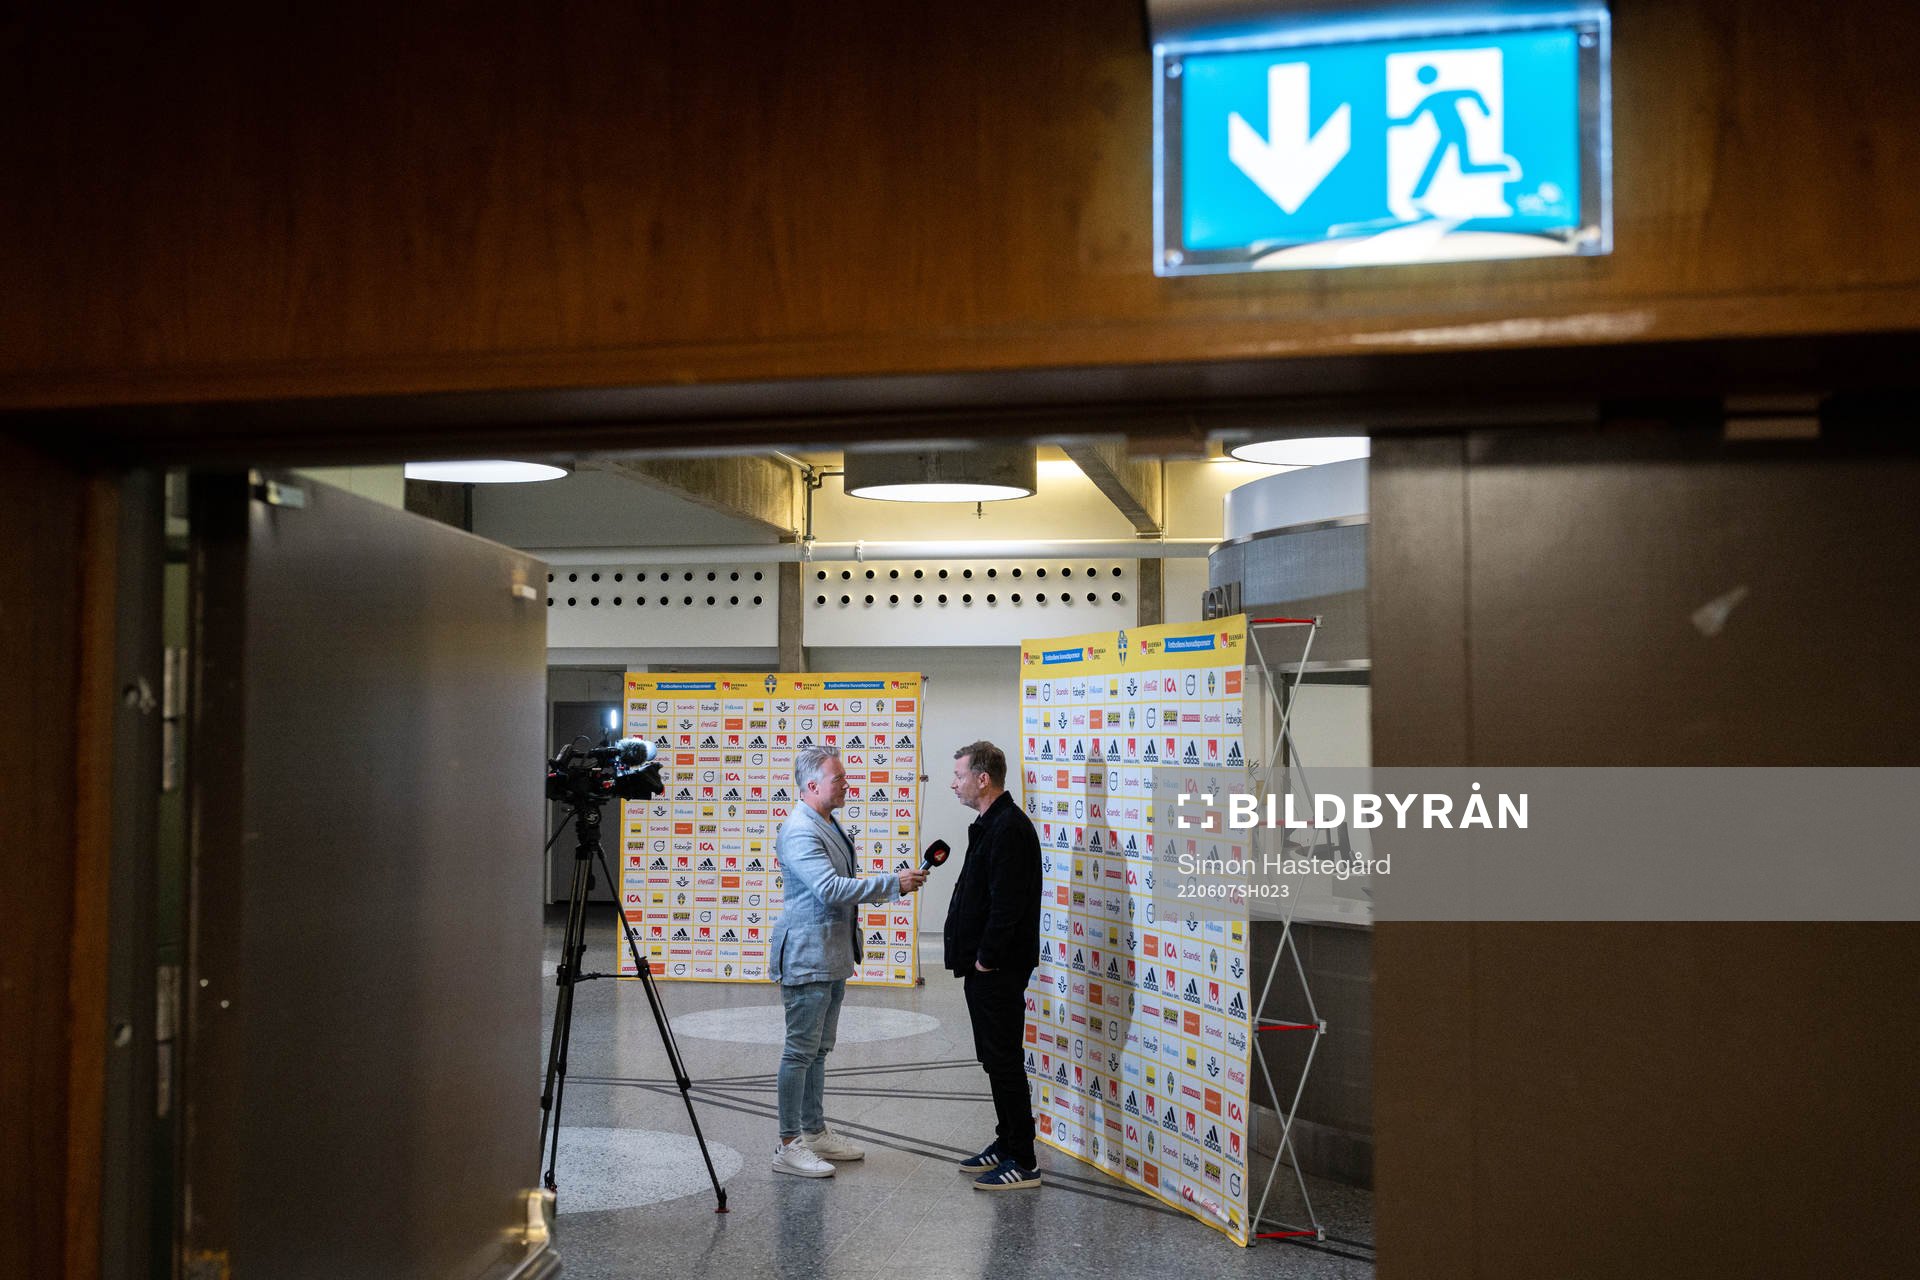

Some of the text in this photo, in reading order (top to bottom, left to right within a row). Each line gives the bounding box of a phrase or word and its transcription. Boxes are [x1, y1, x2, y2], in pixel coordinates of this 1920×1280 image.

[1164, 678, 1176, 692] ICA
[824, 703, 839, 711] ICA
[1183, 757, 1200, 765] adidas
[1227, 758, 1244, 767] adidas
[1028, 771, 1036, 784] ICA
[1185, 778, 1198, 793] ICA
[773, 808, 788, 816] ICA
[896, 809, 911, 817] ICA
[1091, 804, 1101, 818] ICA
[699, 842, 714, 851] ICA
[1057, 841, 1069, 849] adidas
[1089, 845, 1103, 853] adidas
[1124, 850, 1139, 858] adidas
[1126, 870, 1137, 885] ICA
[627, 895, 641, 903] ICA
[894, 916, 909, 925] ICA
[1073, 922, 1084, 937] ICA
[1164, 942, 1177, 959] ICA
[1041, 953, 1053, 962] adidas
[1072, 962, 1085, 971] adidas
[1106, 970, 1120, 981] adidas
[1143, 981, 1159, 992] adidas
[1184, 993, 1200, 1005] adidas
[1228, 1007, 1246, 1020] adidas
[1055, 1075, 1068, 1086] adidas
[1089, 1090, 1103, 1100] adidas
[1125, 1105, 1139, 1116] adidas
[1228, 1101, 1242, 1124] ICA
[1163, 1120, 1179, 1133] adidas
[1126, 1124, 1138, 1143] ICA
[1204, 1139, 1221, 1154] adidas
[1182, 1185, 1194, 1202] ICA
